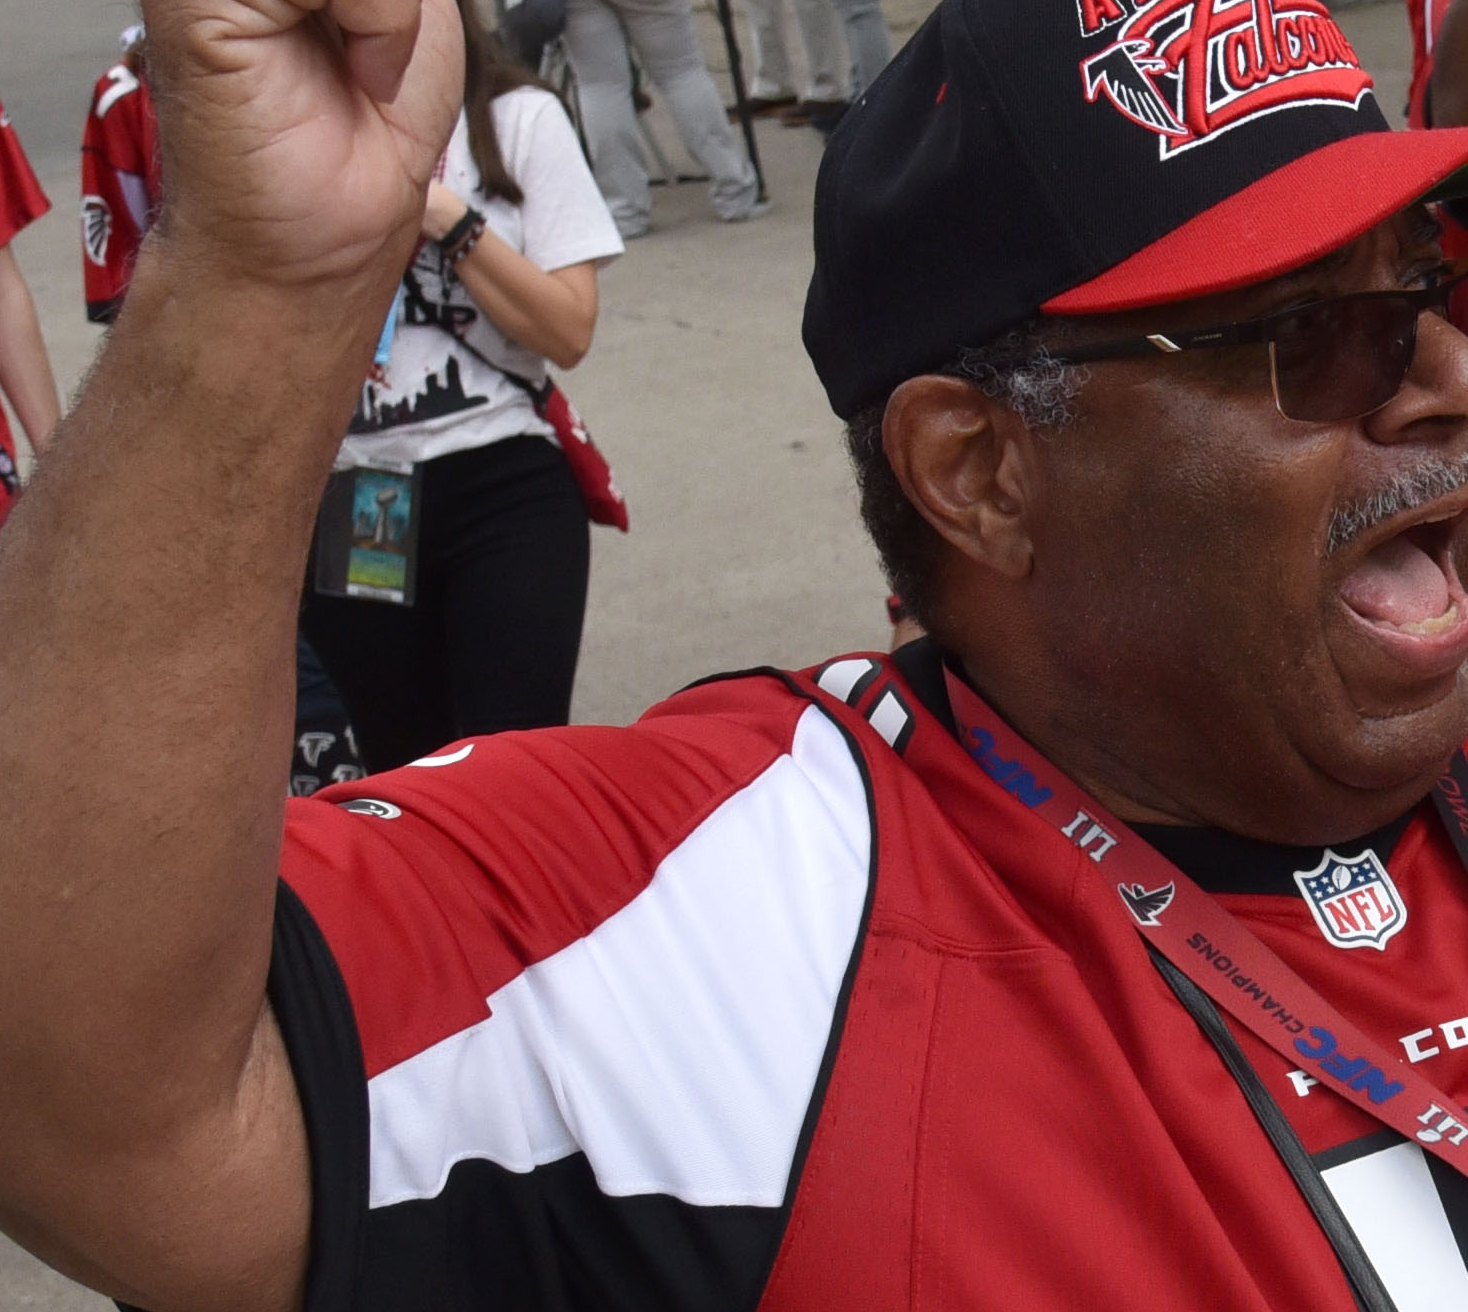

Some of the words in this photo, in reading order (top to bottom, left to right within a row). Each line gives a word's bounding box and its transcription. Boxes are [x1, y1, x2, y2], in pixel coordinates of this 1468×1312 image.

[1324, 886, 1395, 935] NFL
[1185, 930, 1305, 1035] CHAMPIONS
[1293, 1025, 1406, 1105] NFC
